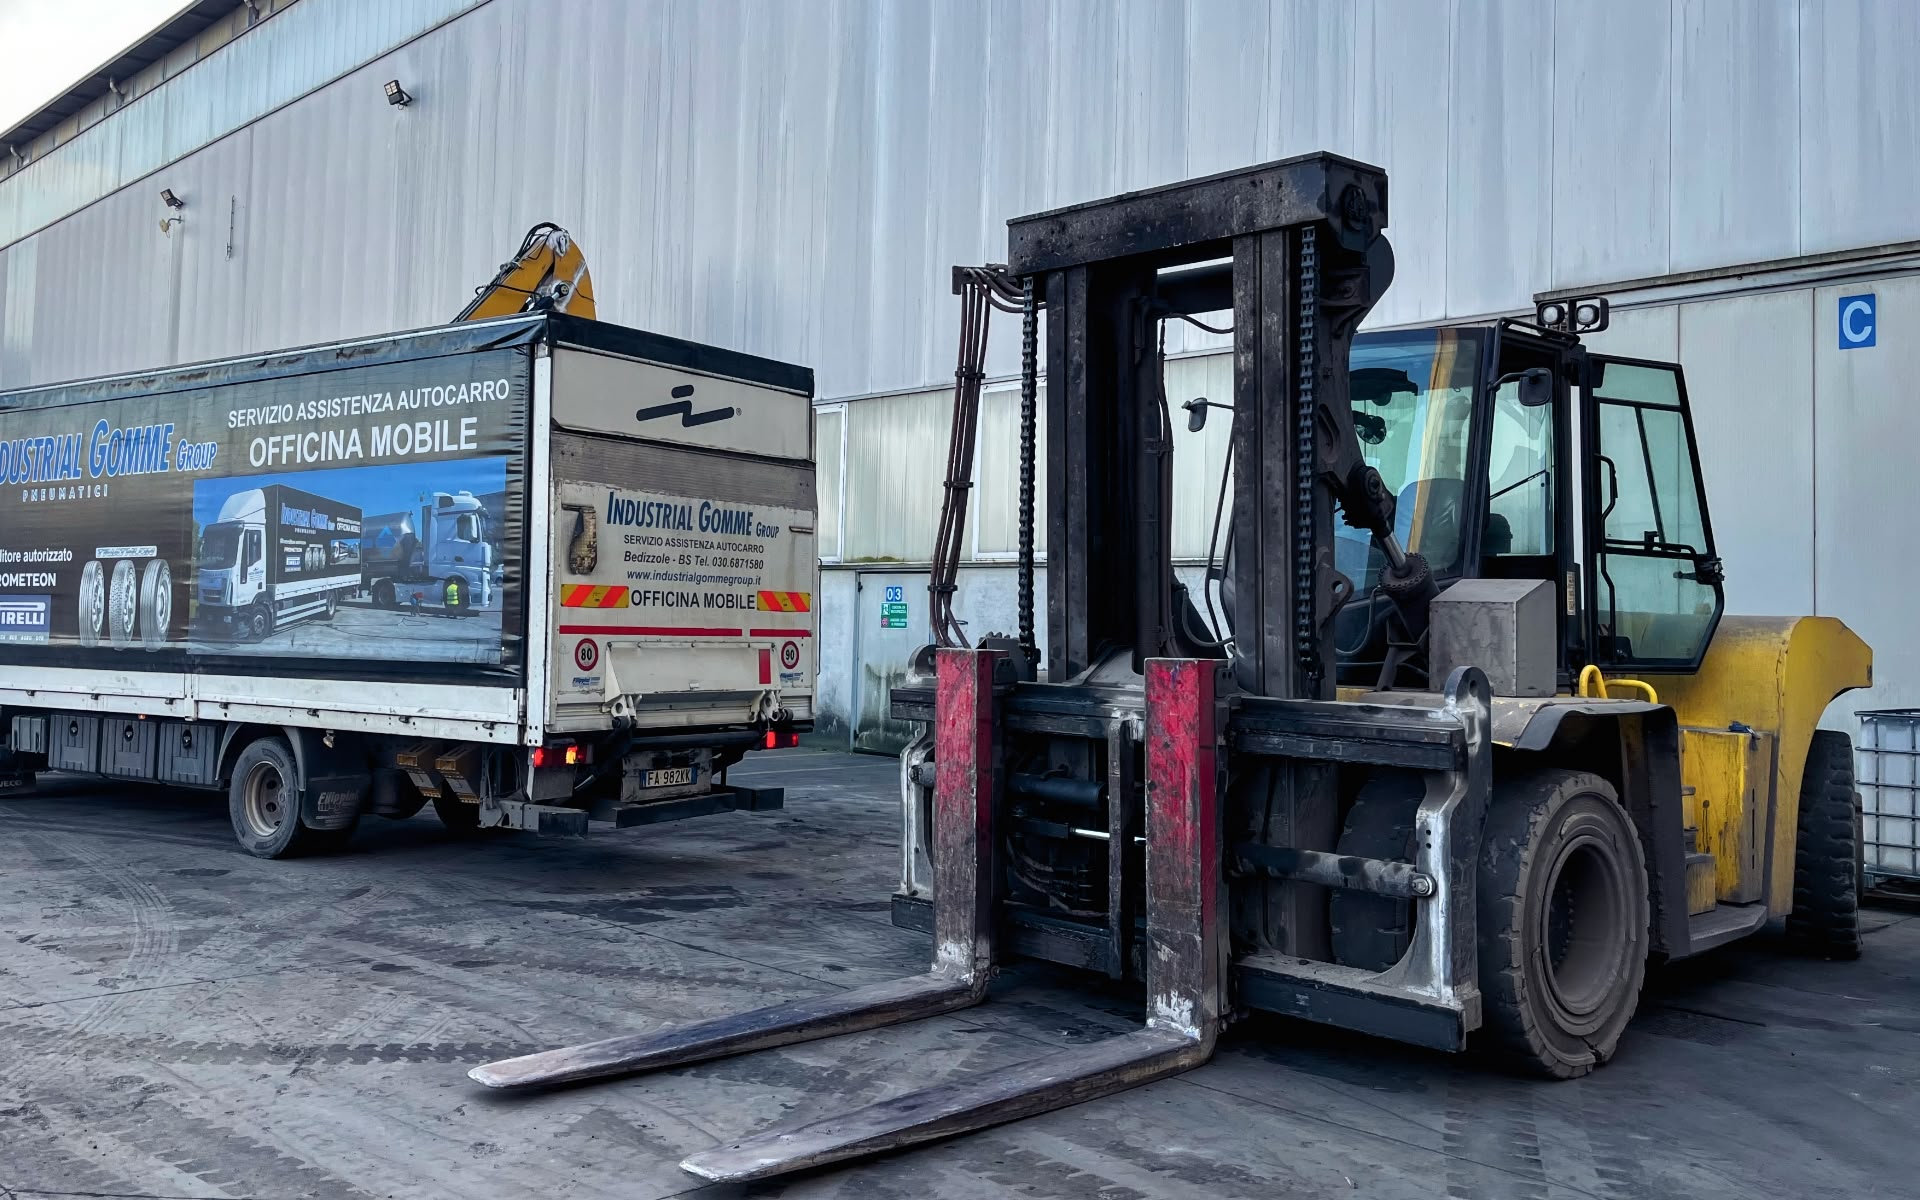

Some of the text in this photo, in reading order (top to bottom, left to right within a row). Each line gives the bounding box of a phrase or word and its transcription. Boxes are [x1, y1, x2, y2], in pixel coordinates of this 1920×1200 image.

[1842, 300, 1872, 343] C
[228, 379, 509, 429] SERVIZIO ASSISTENZA AUTOCARRO
[89, 418, 175, 479] GOMME
[175, 439, 217, 472] GROUP
[249, 417, 478, 467] OFFICINA MOBILE
[22, 484, 108, 502] PNEUMATICI
[606, 491, 780, 539] INDUSTRIAL GOMME GROUP
[623, 534, 764, 554] SERVIZIO ASSISTENZA AUTOCARRO
[23, 547, 73, 563] autorizzato
[623, 551, 670, 565] Bedizzole
[678, 554, 692, 565] BS
[694, 555, 710, 567] Tel.
[712, 558, 764, 570] 030.6871580
[0, 572, 57, 588] OMETEON
[627, 570, 761, 587] www.industrialgommegroup.it
[631, 589, 756, 610] OFFICINA MOBILE
[581, 647, 593, 661] 80
[785, 649, 795, 661] 90
[647, 768, 690, 786] FA 982KK
